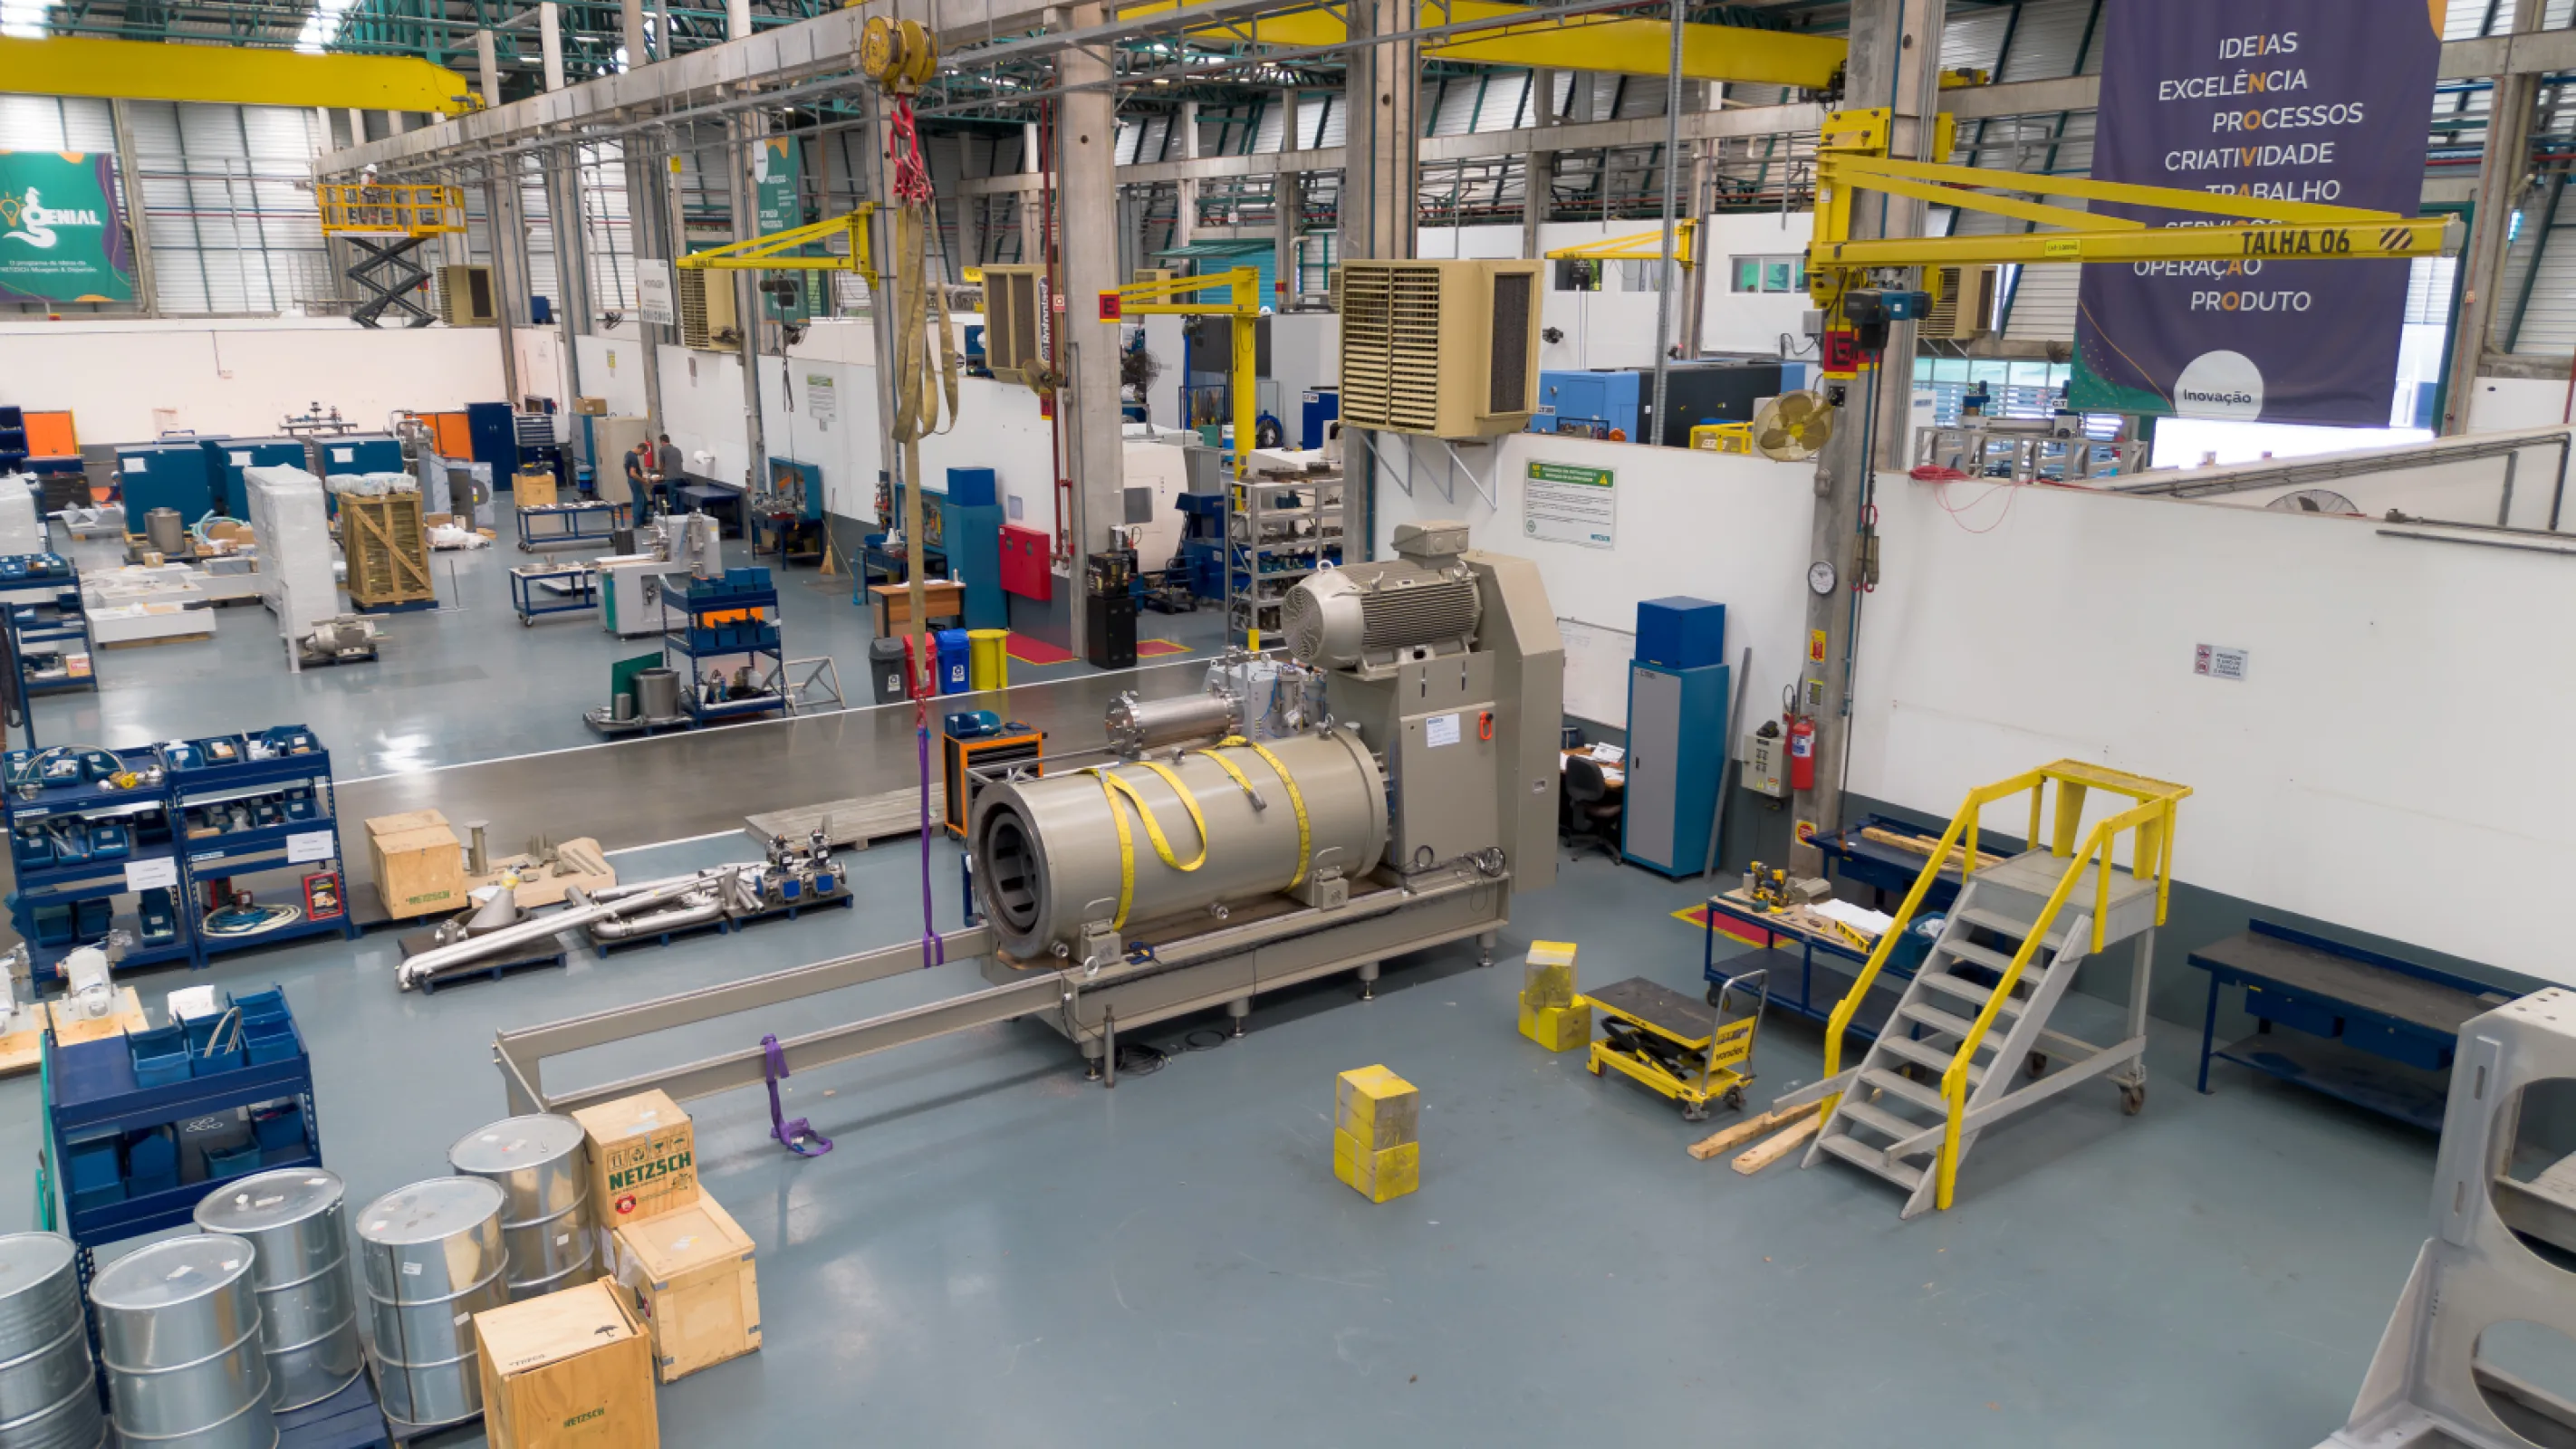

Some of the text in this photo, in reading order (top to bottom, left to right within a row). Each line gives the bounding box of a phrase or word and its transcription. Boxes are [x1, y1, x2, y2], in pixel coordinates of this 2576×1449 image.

[2218, 32, 2299, 60] IDEIAS
[2158, 68, 2309, 101] EXCELÊNCIA
[2212, 102, 2364, 132] PROCESSOS
[2165, 142, 2335, 171] CRIATIVIDADE
[2241, 228, 2350, 255] TALHA 06
[1104, 298, 1117, 314] E
[2189, 289, 2312, 312] PRODUTO
[2183, 389, 2253, 407] Inovação
[609, 1151, 692, 1191] NETZSCH
[563, 1406, 605, 1428] NETZSCH
